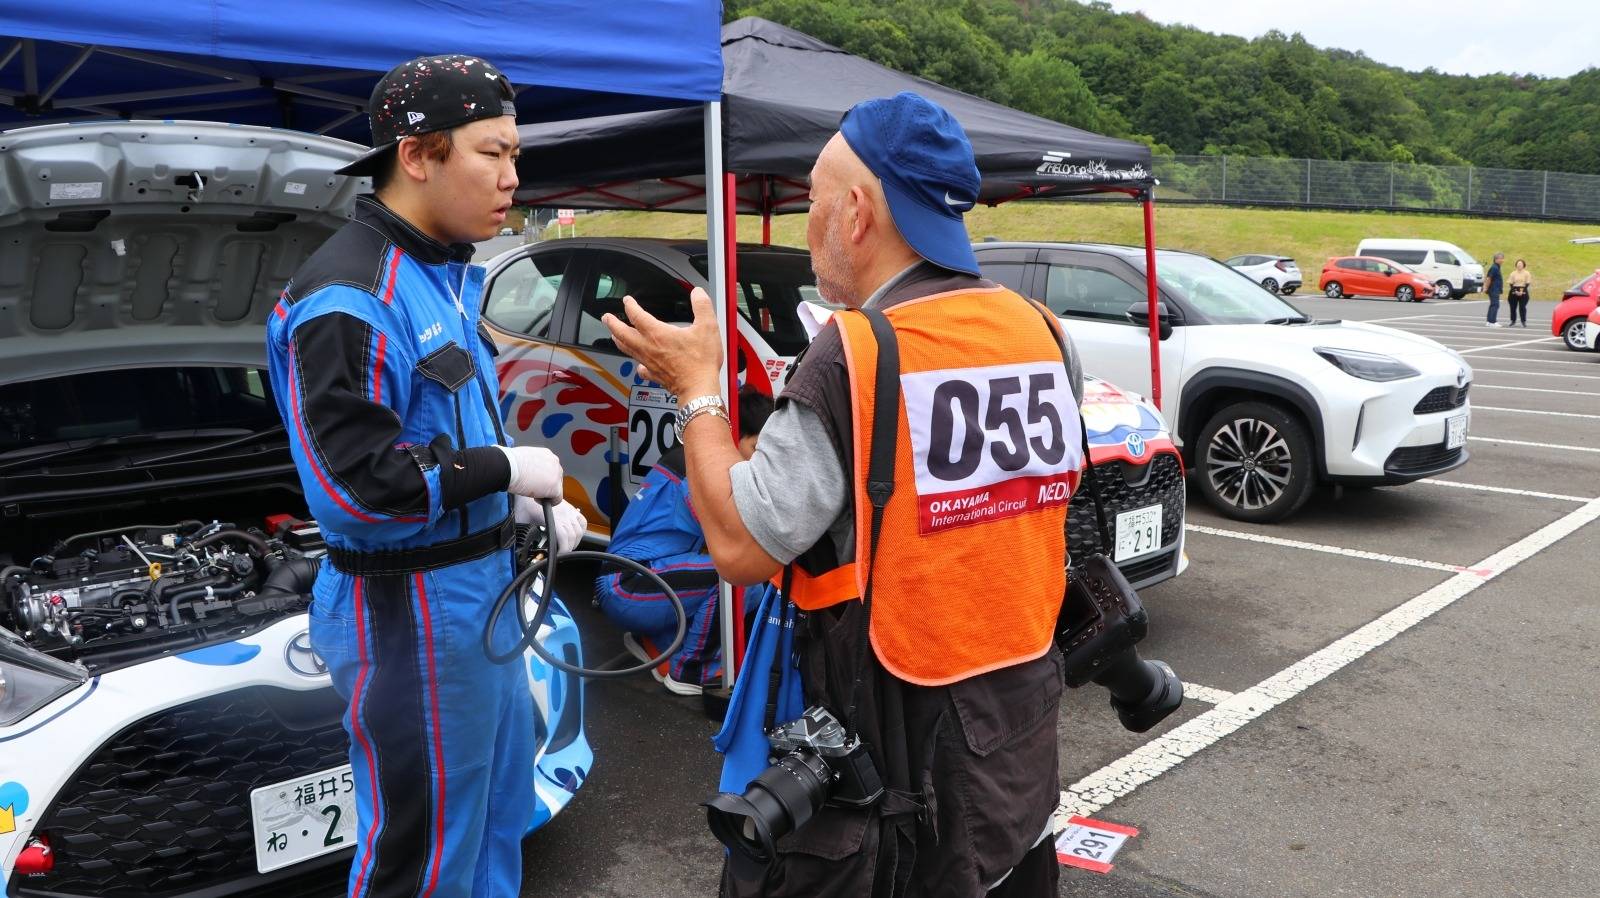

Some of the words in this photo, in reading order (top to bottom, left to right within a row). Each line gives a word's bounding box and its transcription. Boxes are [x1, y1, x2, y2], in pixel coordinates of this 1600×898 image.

[664, 393, 678, 404] Ya
[927, 373, 1066, 482] 055
[631, 409, 677, 476] 29
[930, 491, 990, 514] OKAYAMA
[931, 504, 997, 527] International
[295, 772, 353, 806] 福井5
[1072, 831, 1116, 859] 291
